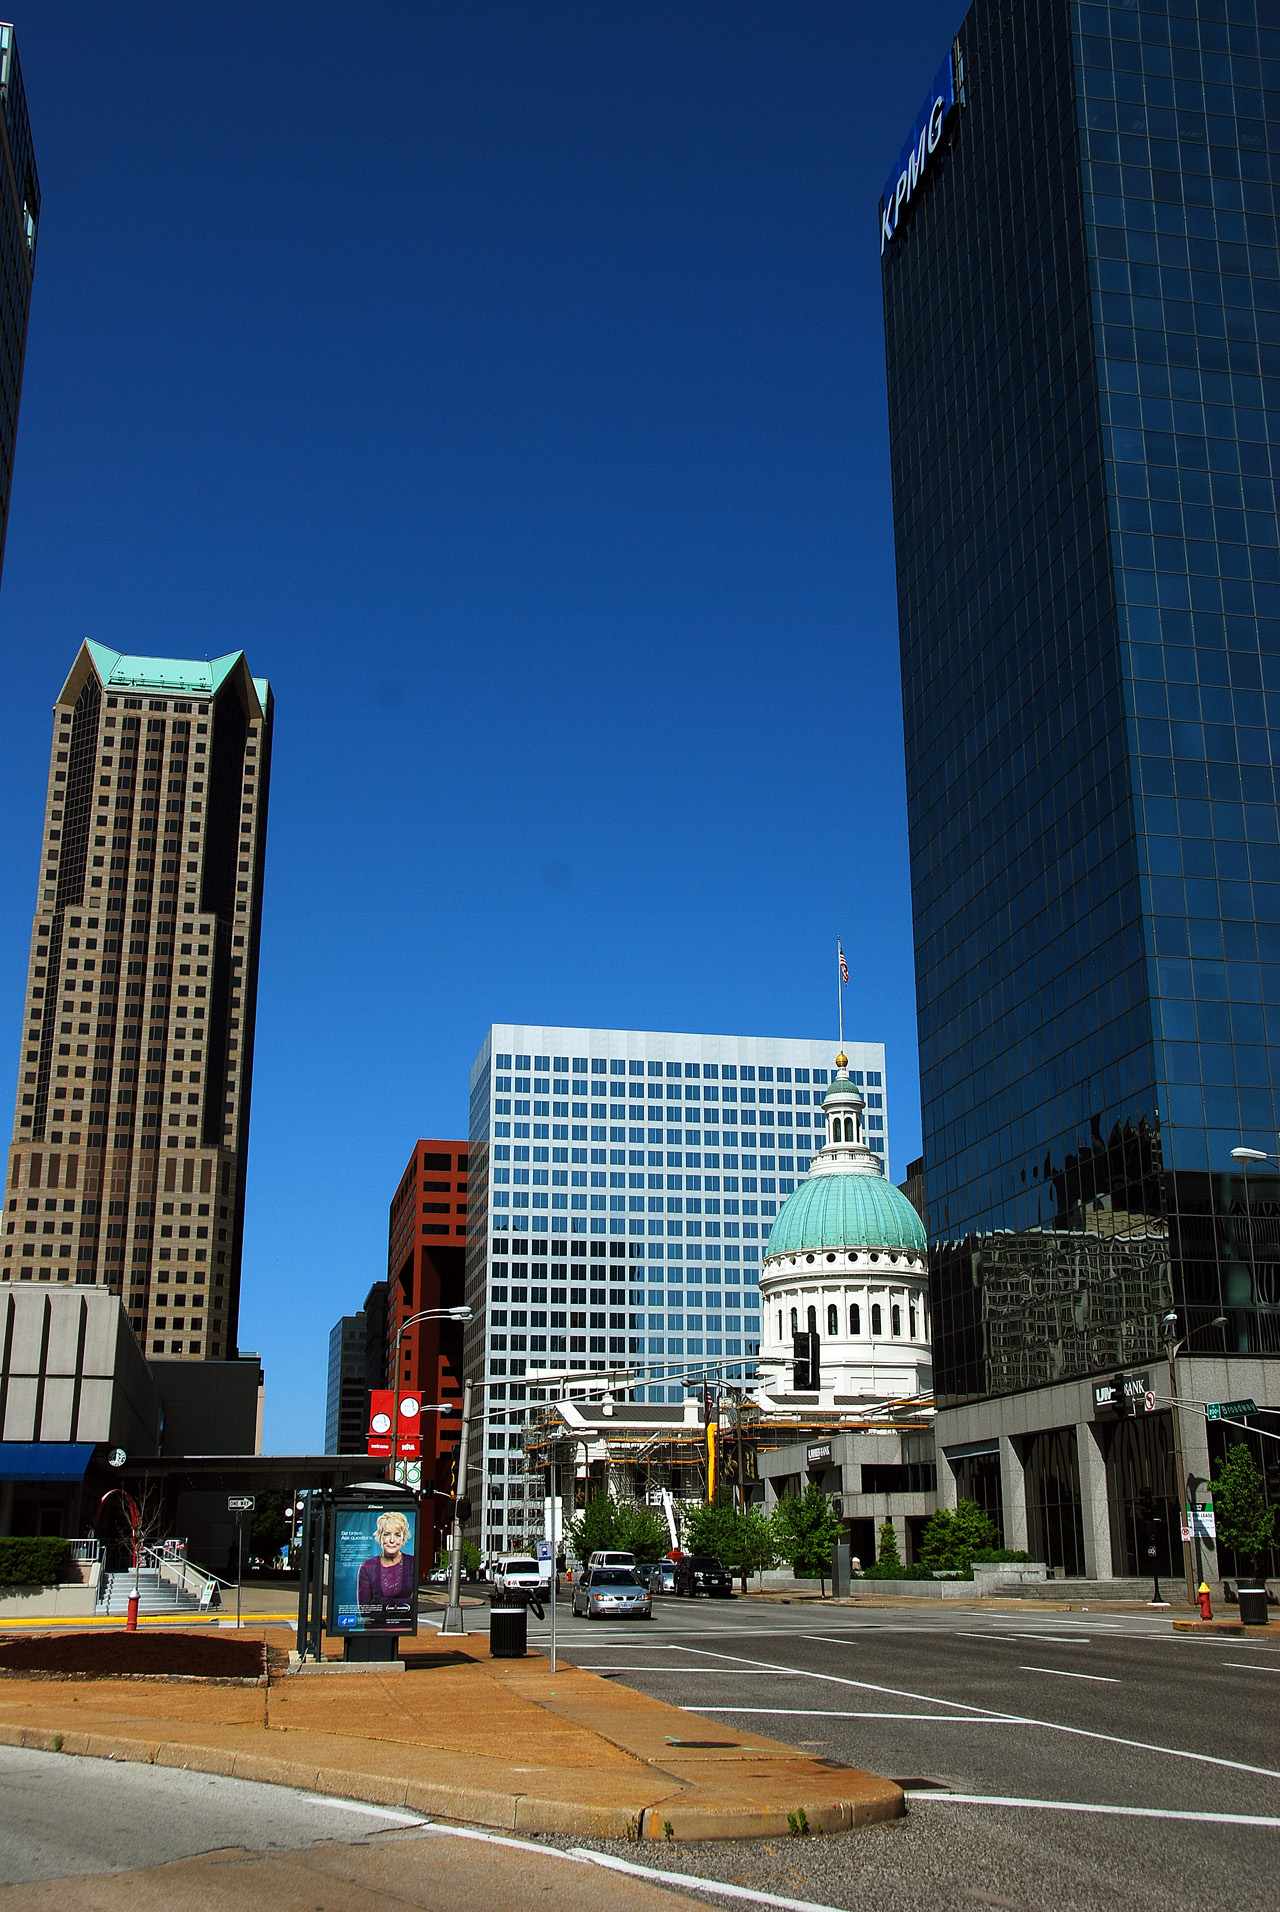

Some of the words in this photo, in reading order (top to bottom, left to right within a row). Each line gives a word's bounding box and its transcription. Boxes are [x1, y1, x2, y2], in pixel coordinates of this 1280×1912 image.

[881, 96, 944, 257] KPMG
[1124, 1379, 1145, 1396] BANK
[1221, 1402, 1257, 1415] Broadway
